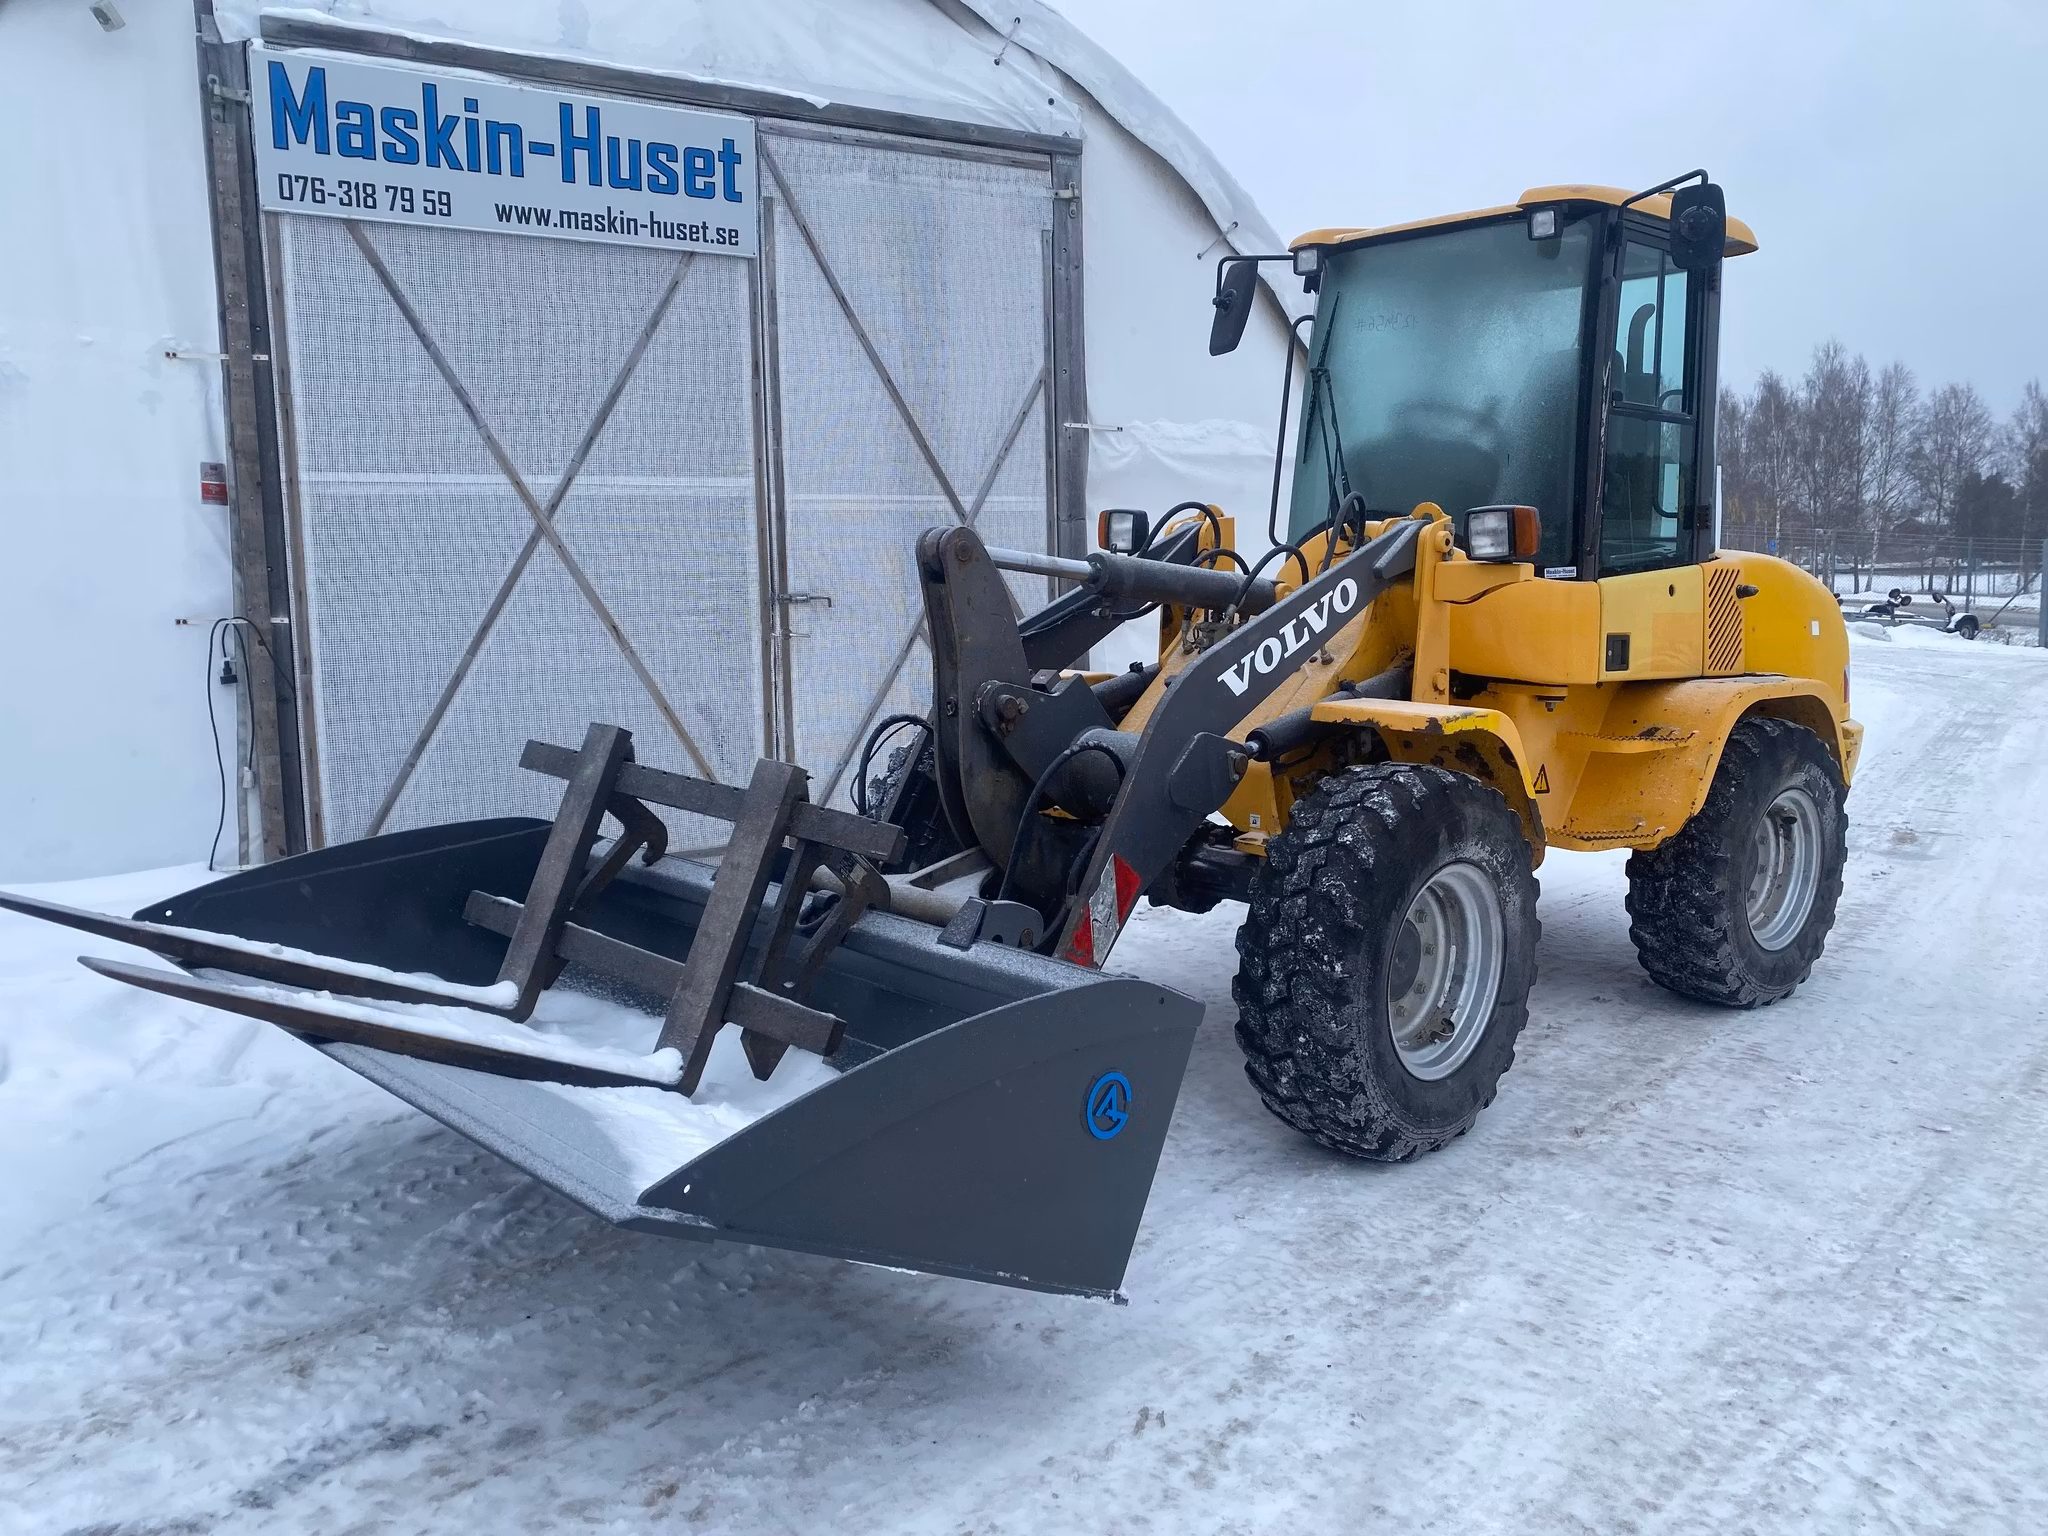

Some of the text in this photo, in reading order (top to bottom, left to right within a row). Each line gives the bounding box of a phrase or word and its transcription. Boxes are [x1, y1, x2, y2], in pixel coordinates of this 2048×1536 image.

[267, 60, 743, 203] Maskin-Huset
[278, 173, 452, 217] 076-318 79 59
[494, 203, 739, 246] www.maskin-huset.se
[1216, 577, 1358, 697] VOLVO
